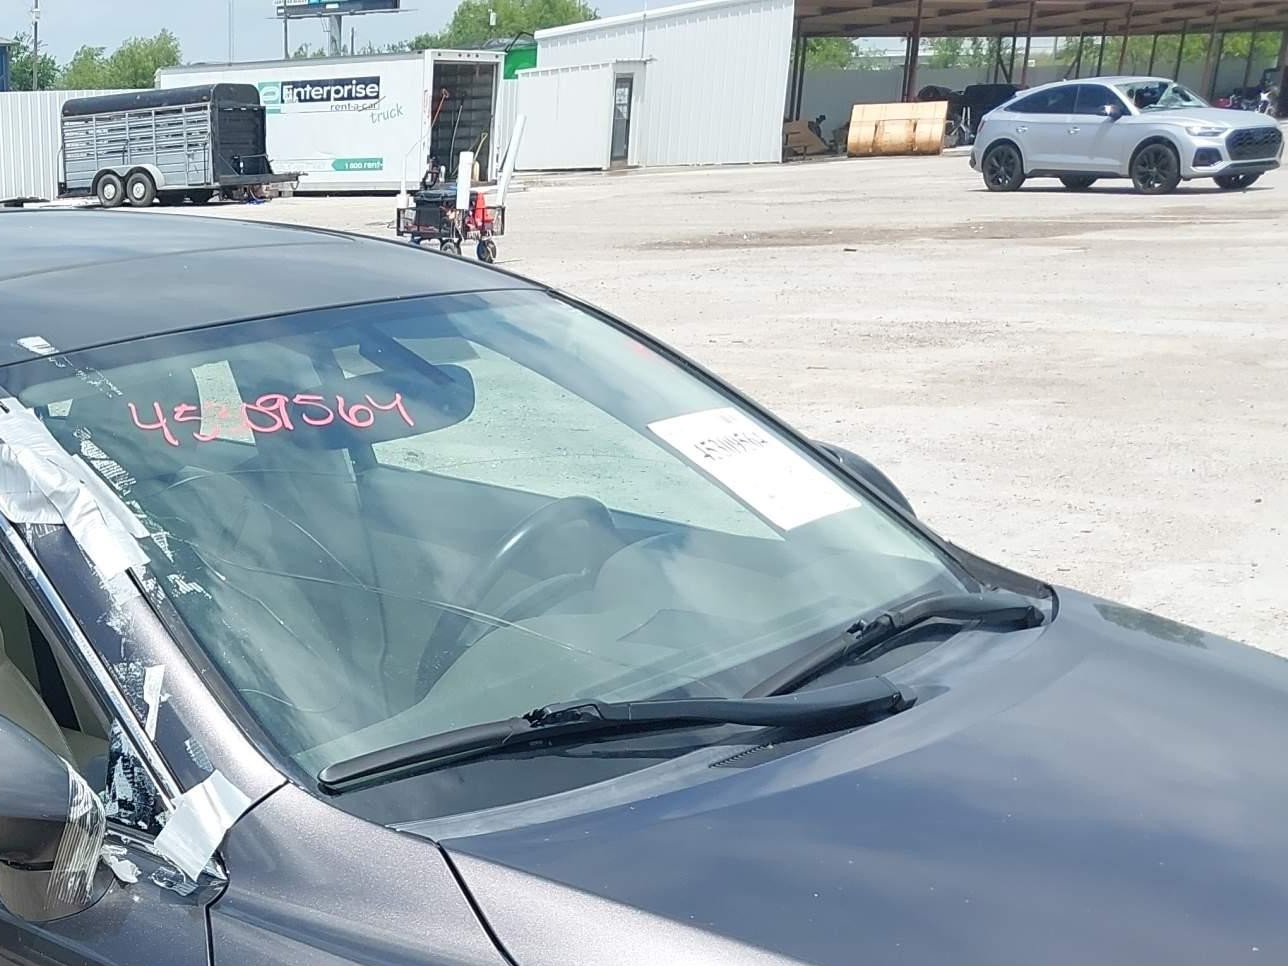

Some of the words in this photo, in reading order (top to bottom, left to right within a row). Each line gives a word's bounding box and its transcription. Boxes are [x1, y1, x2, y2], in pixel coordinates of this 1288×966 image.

[282, 80, 379, 103] Enterprise
[330, 102, 378, 111] rent-a-car
[370, 104, 404, 124] truck
